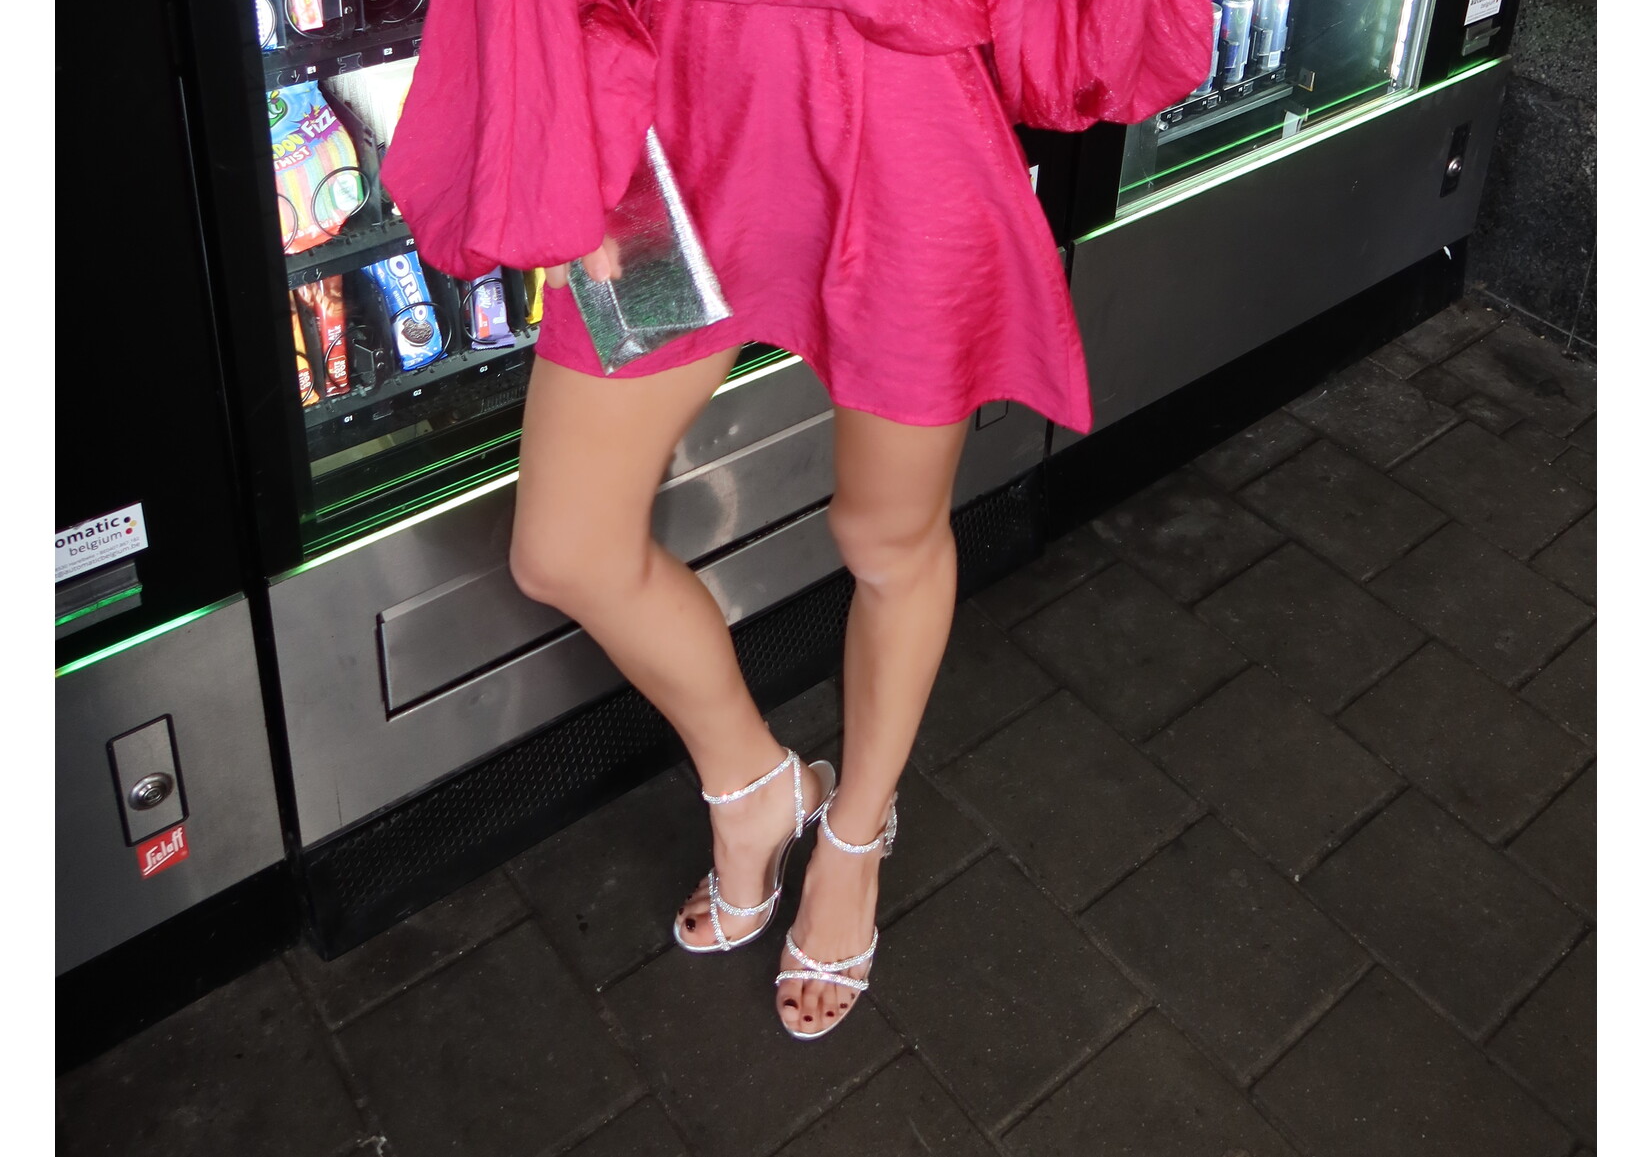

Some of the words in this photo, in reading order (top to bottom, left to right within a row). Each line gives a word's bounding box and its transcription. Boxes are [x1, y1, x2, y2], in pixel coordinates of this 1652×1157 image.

[383, 47, 393, 56] E2
[307, 65, 317, 74] E1
[405, 238, 415, 246] F2
[388, 254, 428, 321] OREO
[343, 415, 354, 423] G1
[55, 517, 120, 549] omatic
[69, 531, 122, 557] belgium
